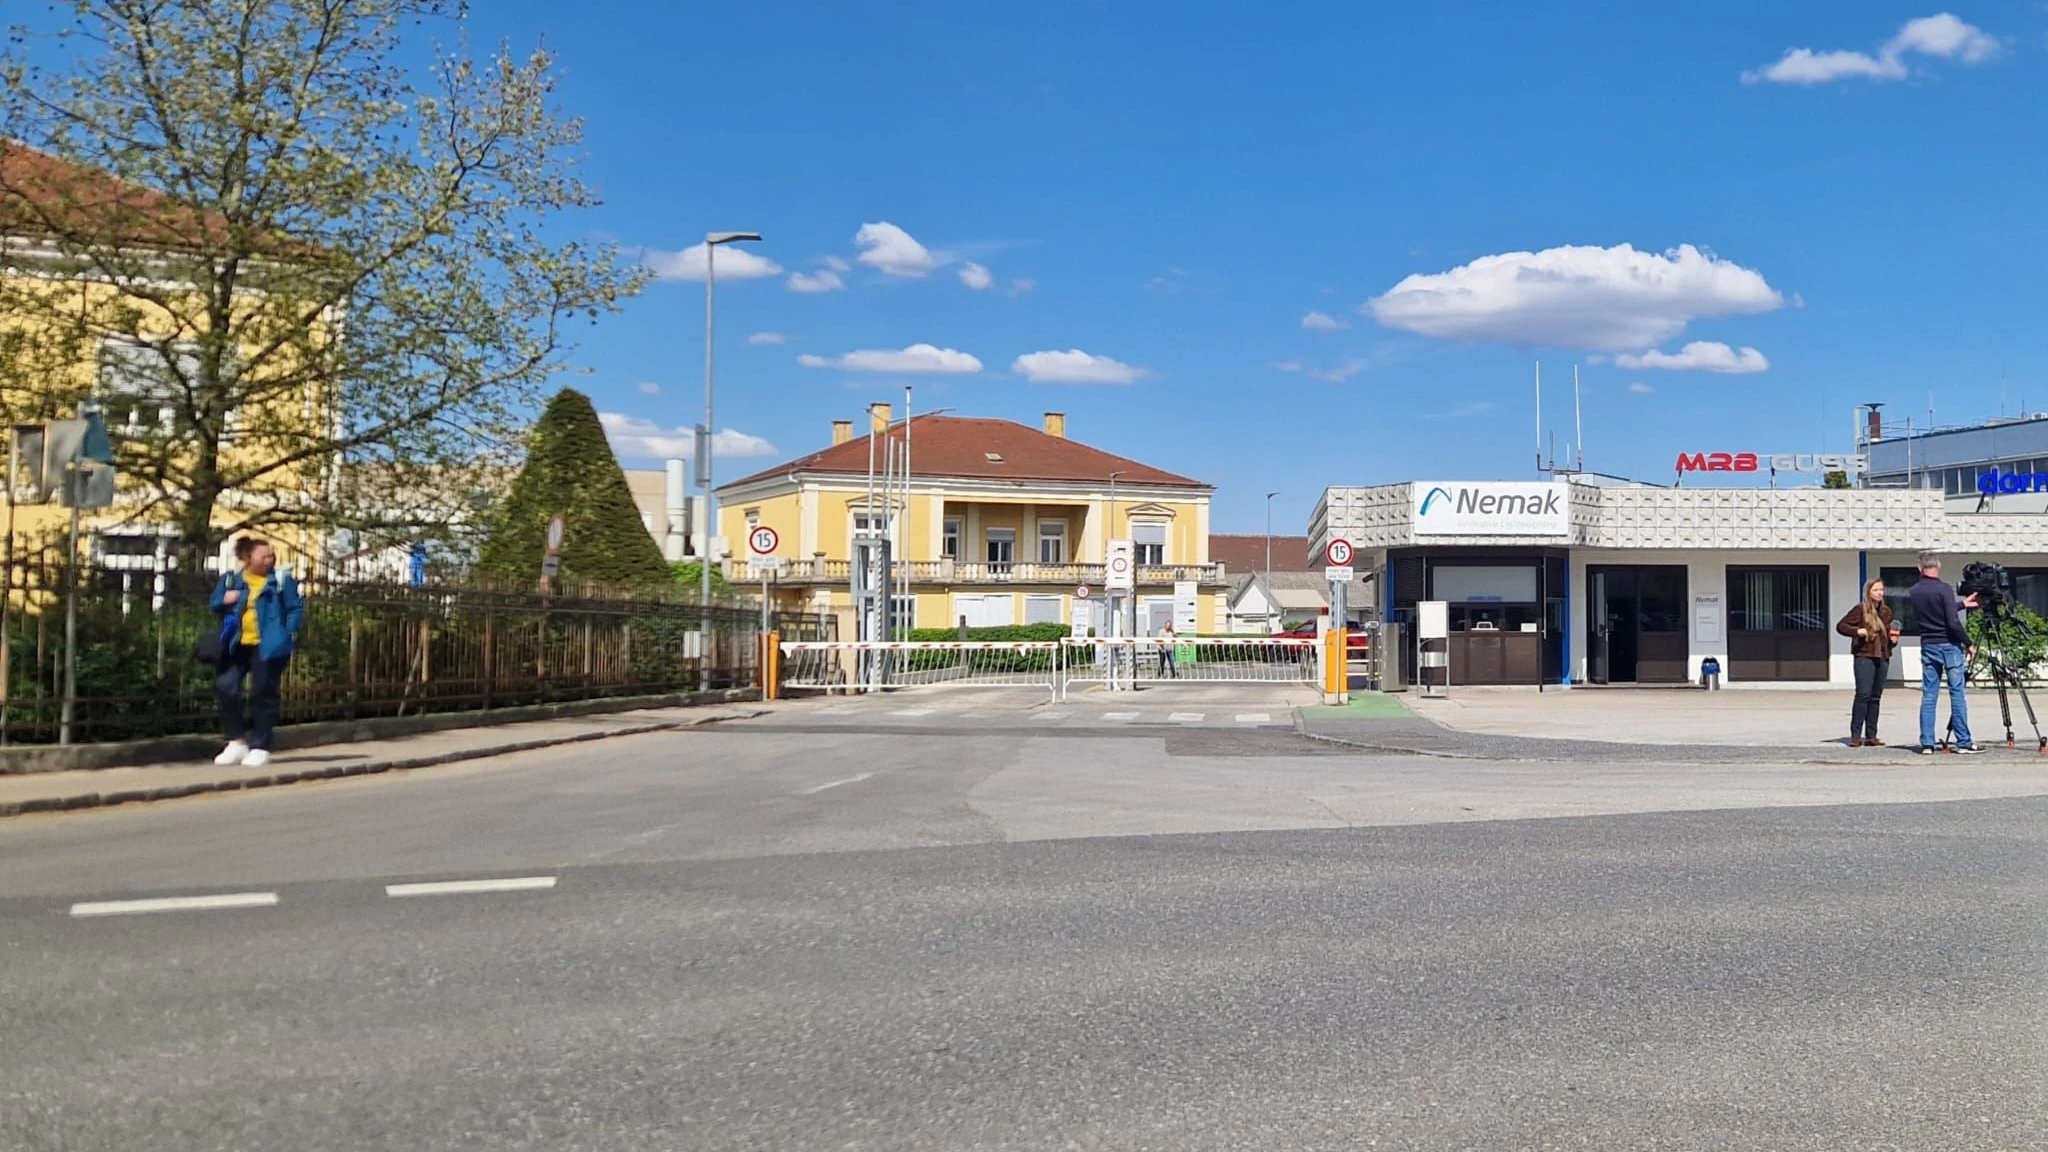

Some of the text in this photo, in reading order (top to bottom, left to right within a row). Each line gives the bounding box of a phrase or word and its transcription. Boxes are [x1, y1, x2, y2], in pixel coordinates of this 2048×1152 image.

[1675, 452, 1868, 473] MRB GUSS
[1456, 488, 1561, 515] Nemak
[757, 532, 772, 548] 15
[1334, 545, 1346, 560] 15
